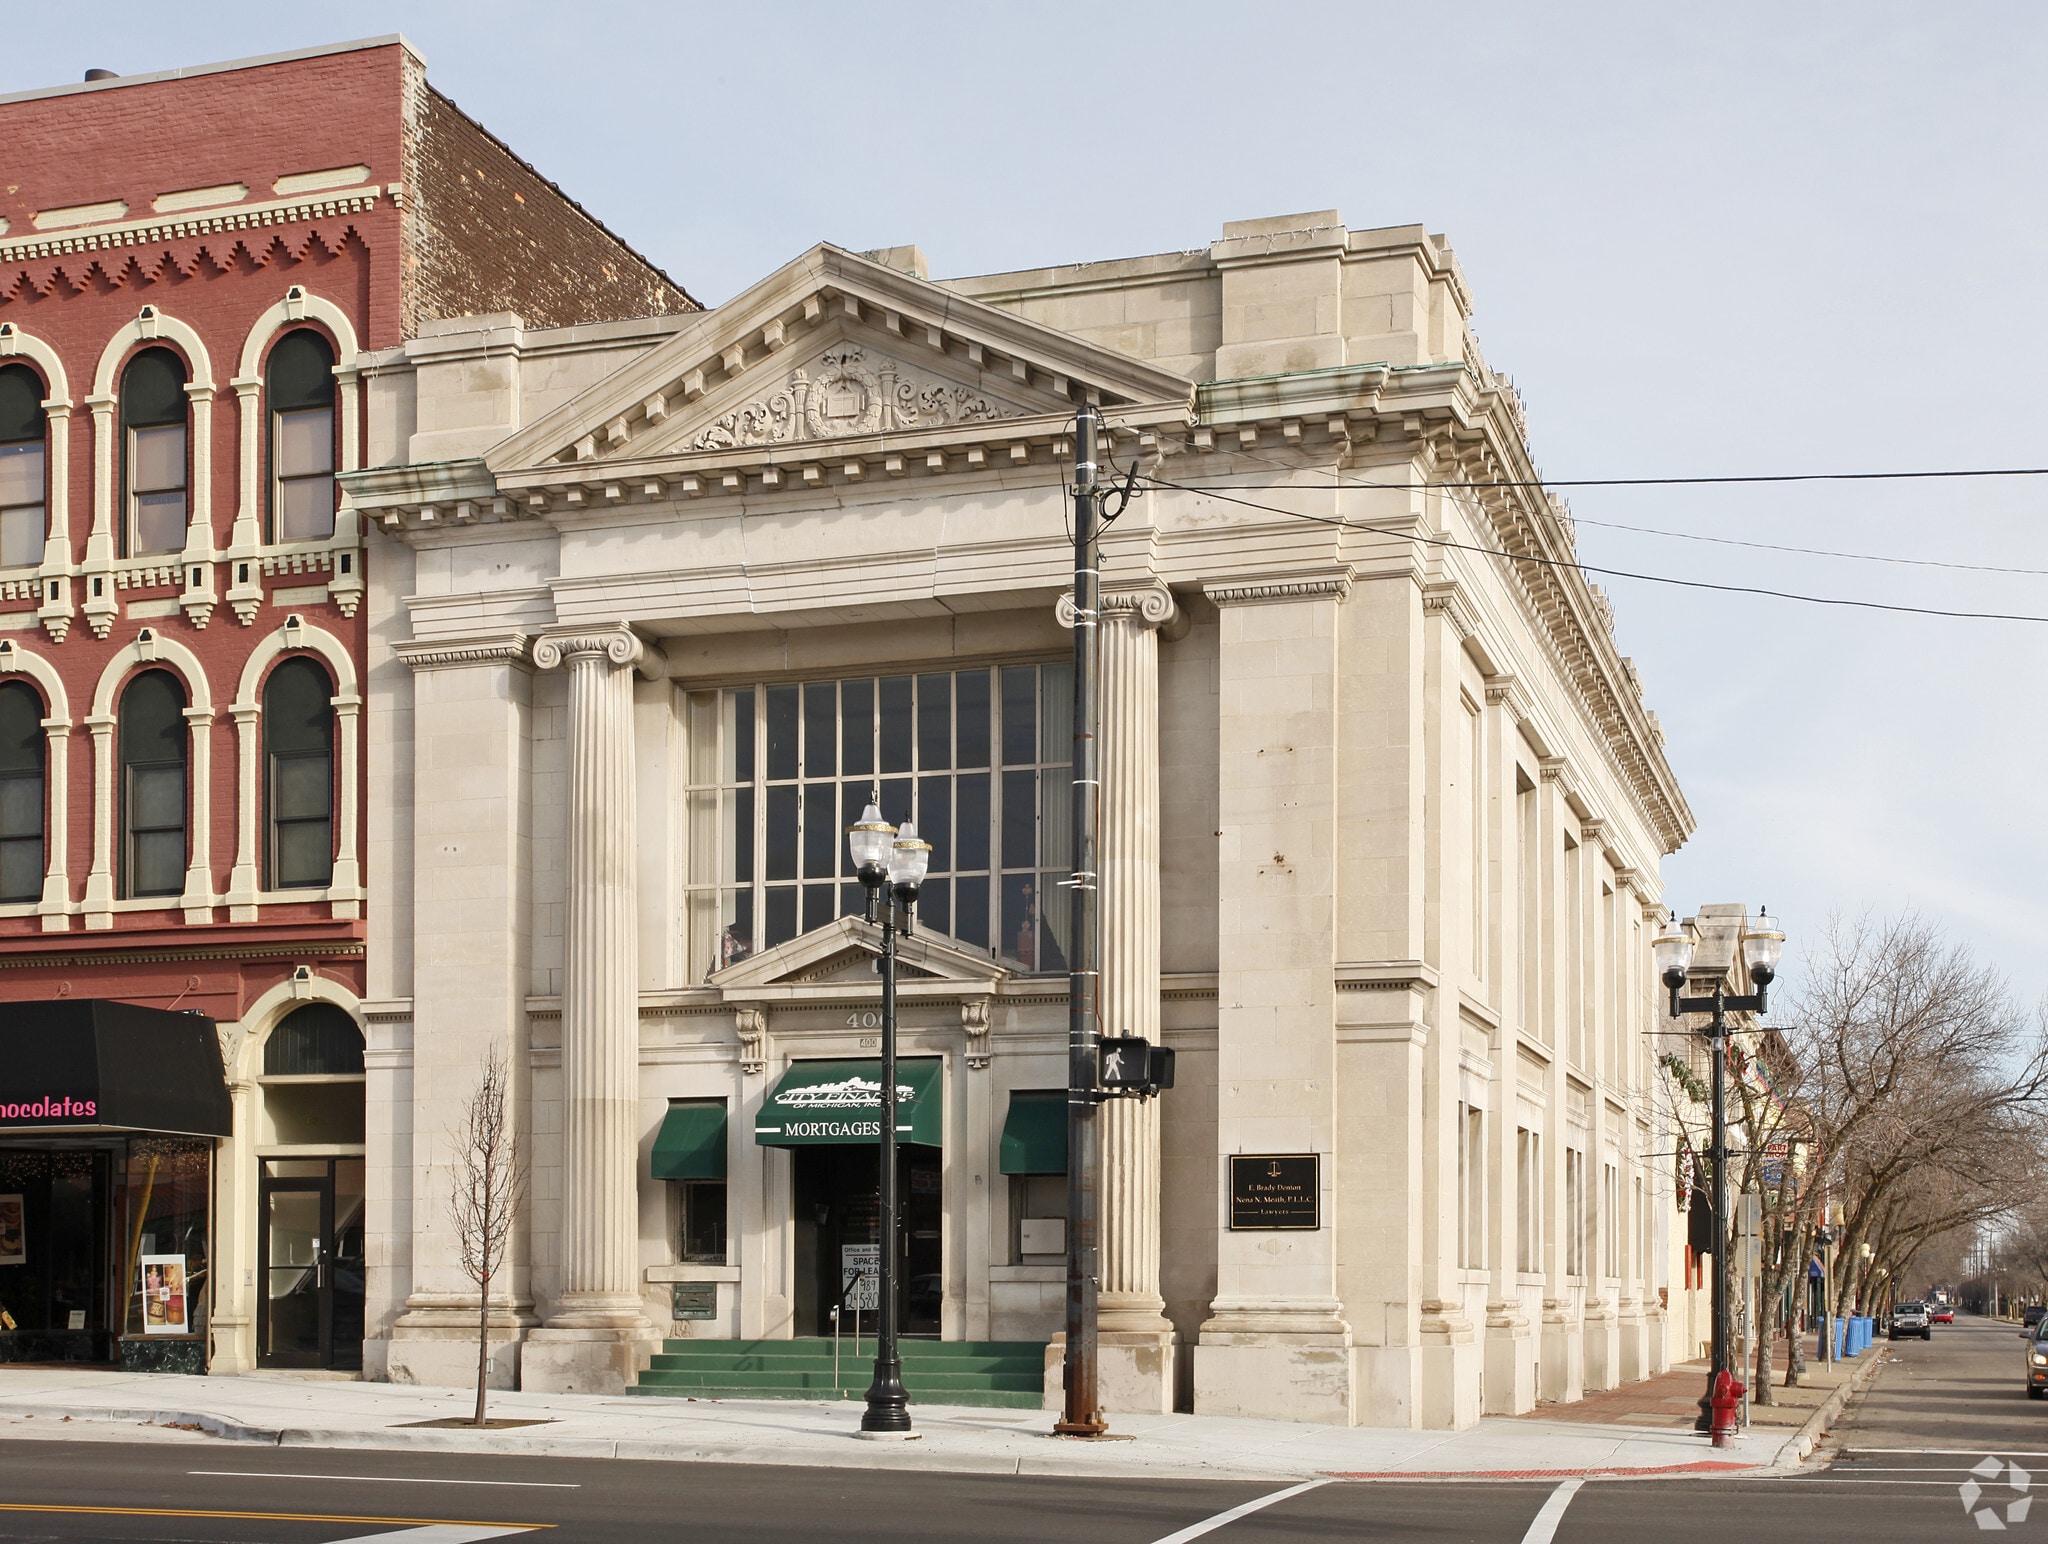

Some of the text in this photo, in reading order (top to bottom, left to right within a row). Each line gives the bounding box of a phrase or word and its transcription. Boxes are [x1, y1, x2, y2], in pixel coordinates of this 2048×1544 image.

[846, 1012, 883, 1028] 40
[860, 1039, 876, 1047] 400
[775, 1091, 916, 1101] CITY FINAE
[785, 1122, 880, 1137] MORTGAGES
[1256, 1184, 1275, 1193] Brady
[853, 1257, 880, 1265] SPACE
[863, 1267, 879, 1276] LEA
[860, 1280, 876, 1291] 989
